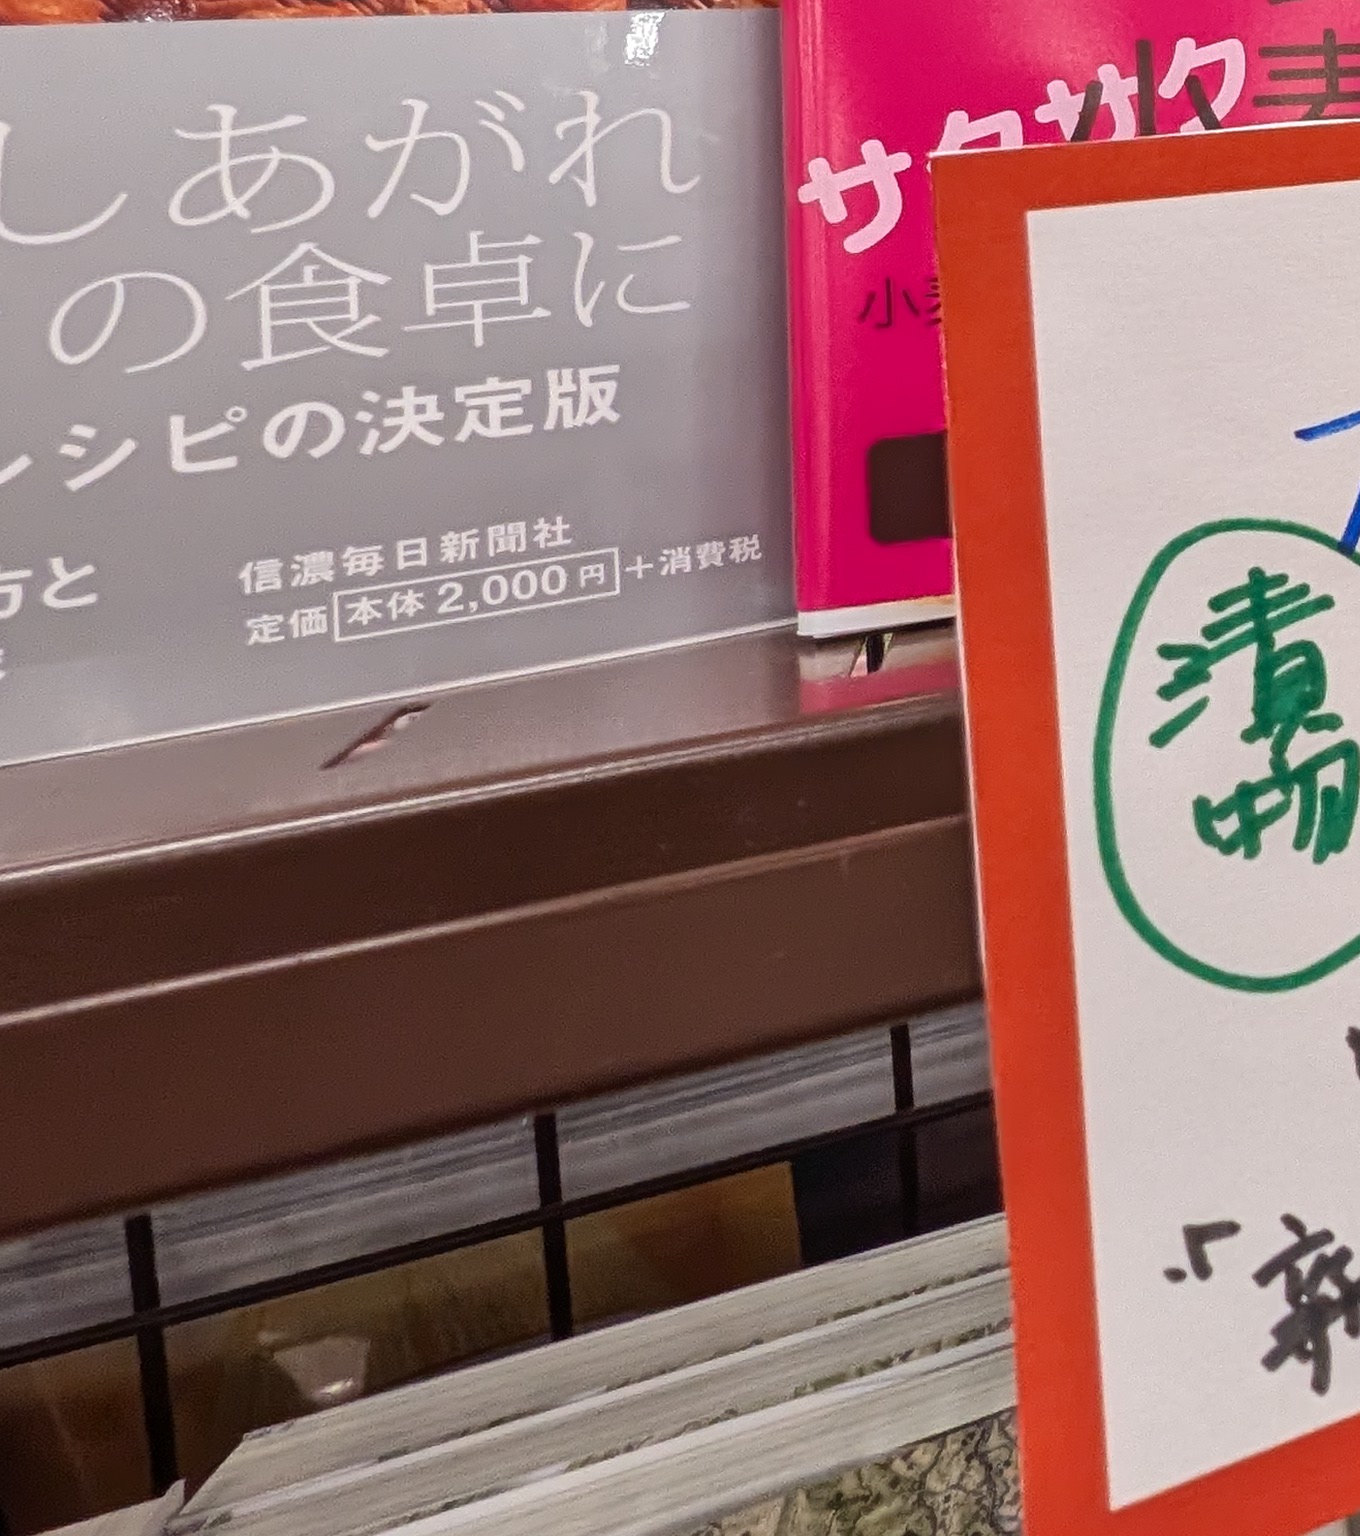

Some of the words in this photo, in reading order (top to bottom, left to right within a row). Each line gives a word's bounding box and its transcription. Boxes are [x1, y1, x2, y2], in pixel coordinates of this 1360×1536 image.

[49, 230, 691, 375] の食卓に
[238, 515, 573, 596] 信濃毎日新聞社
